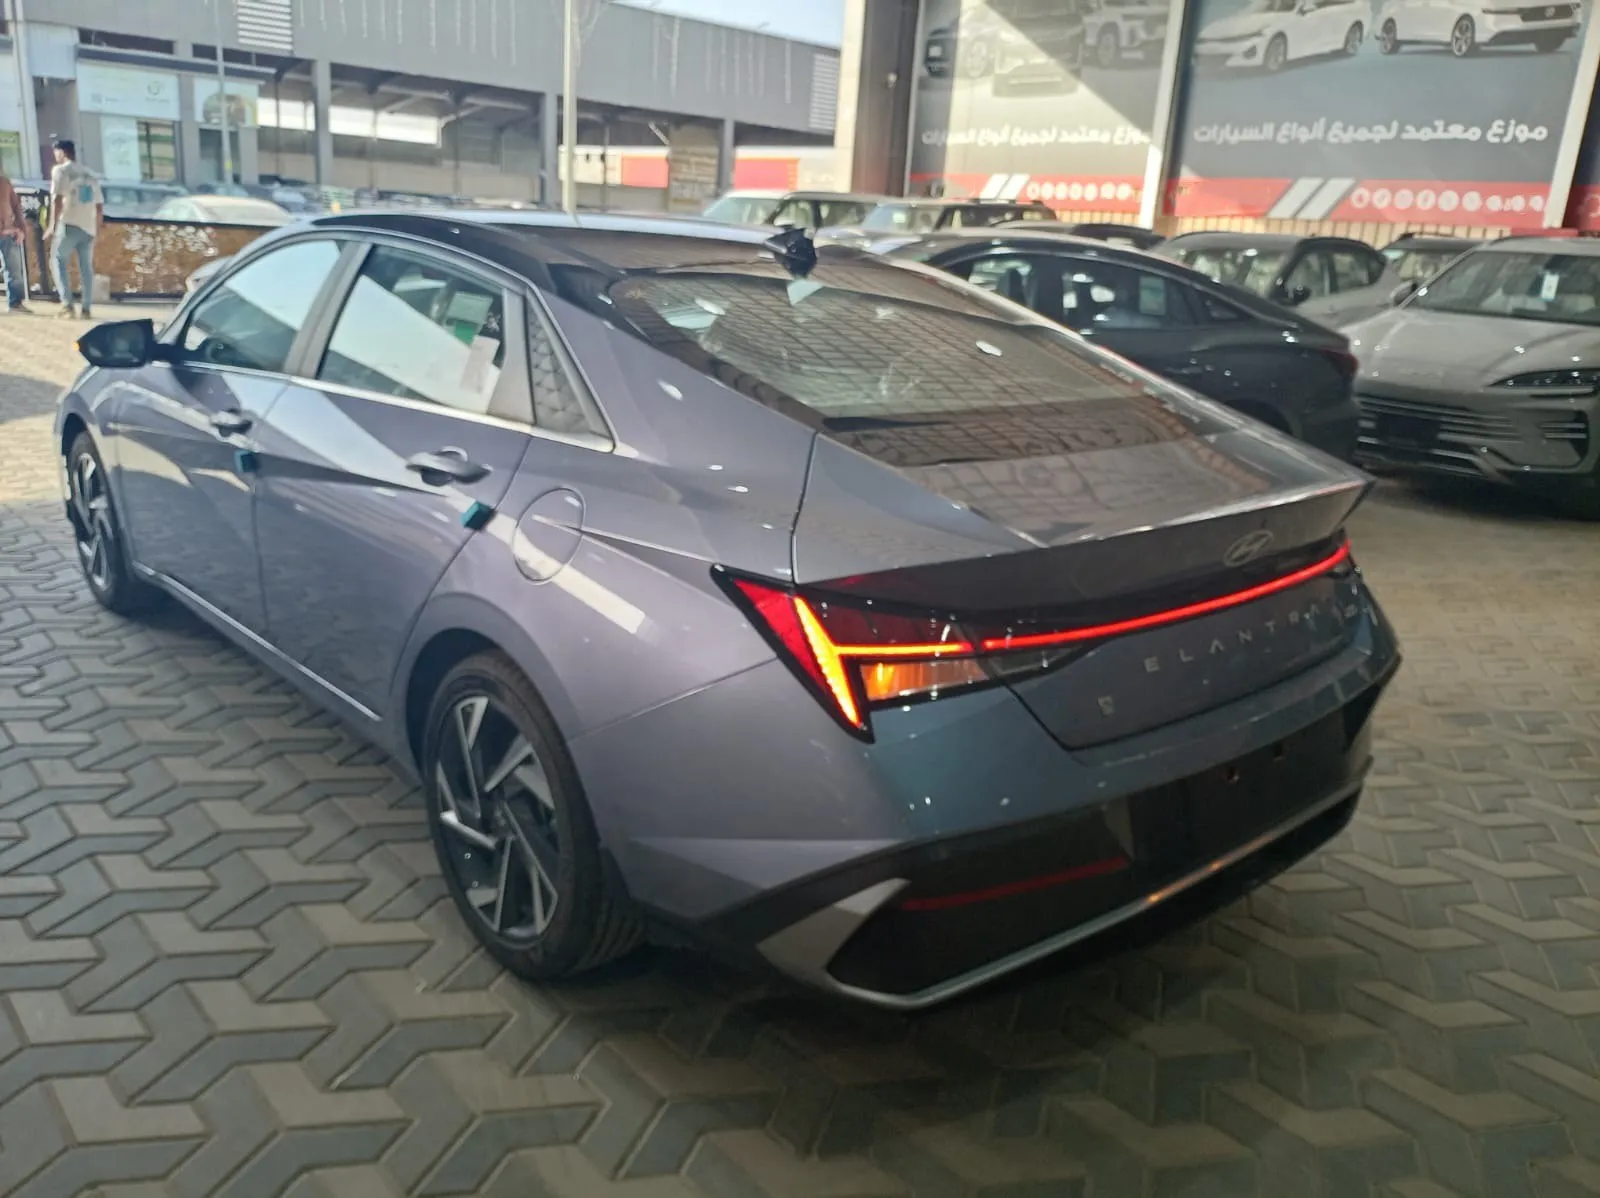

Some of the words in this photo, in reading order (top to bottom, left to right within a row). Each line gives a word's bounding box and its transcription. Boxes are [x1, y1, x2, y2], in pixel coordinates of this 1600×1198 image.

[1193, 121, 1275, 145] السيارات
[1275, 117, 1327, 144] أنواع
[1326, 119, 1400, 144] لجميع
[1400, 119, 1482, 142] معتمد
[1486, 118, 1549, 143] موزع
[1144, 603, 1320, 673] ELANTRA
